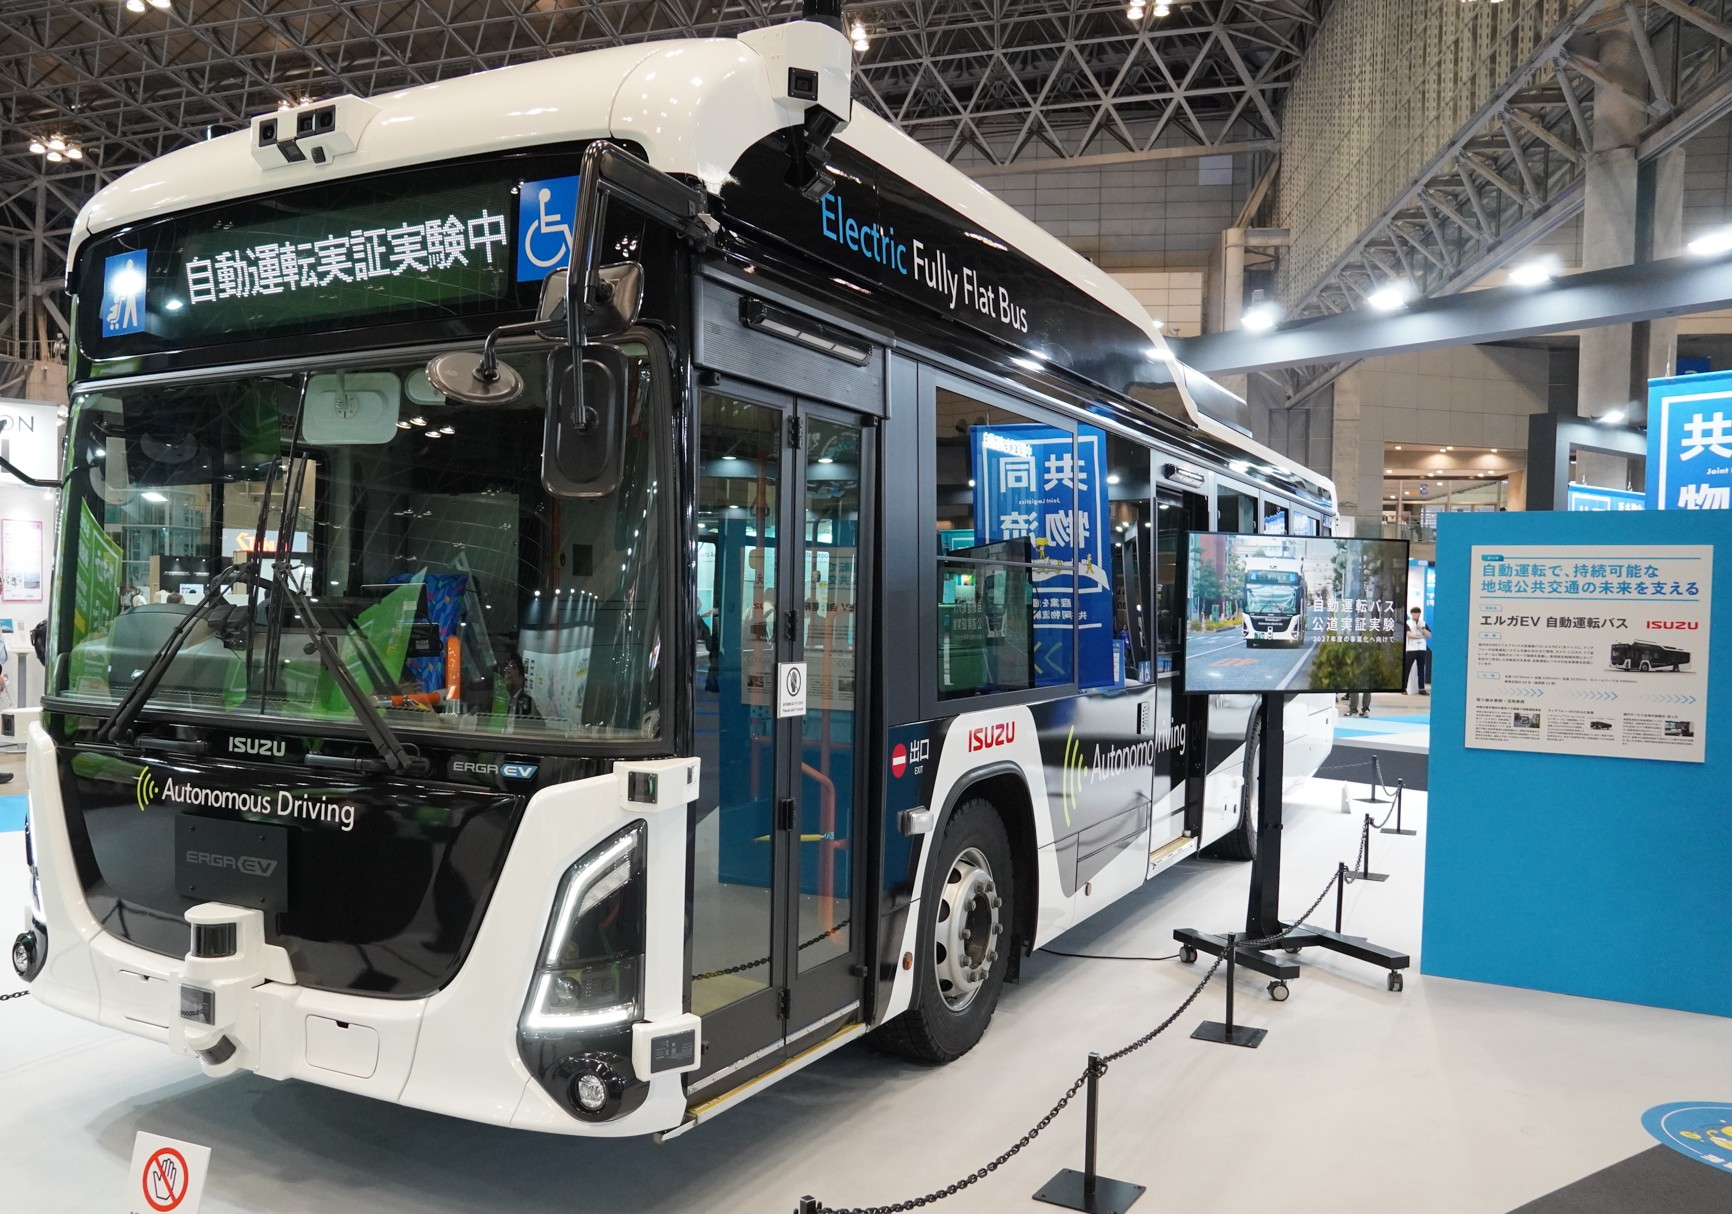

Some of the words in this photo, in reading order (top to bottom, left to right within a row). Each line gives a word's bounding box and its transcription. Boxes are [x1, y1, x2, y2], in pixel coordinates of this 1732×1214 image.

[186, 209, 507, 304] 自動運転実証実験中
[820, 193, 908, 275] Electric
[913, 239, 958, 309] Fully
[963, 266, 995, 318] Flat
[999, 286, 1028, 333] Bus
[1482, 563, 1659, 579] 自動運転で、持続可能な
[1481, 580, 1699, 596] 地域公共交通の未来を支える
[1313, 598, 1395, 613] 自動運転バス
[1312, 617, 1395, 632] 公道実証実験
[1480, 615, 1541, 627] エルガEV
[1546, 616, 1629, 629] 自動運転バス
[1646, 620, 1699, 630] ISUZU
[968, 721, 1015, 753] ISUZU
[1155, 716, 1187, 756] riving
[228, 736, 286, 757] ISUZU
[909, 738, 930, 764] 出口
[453, 761, 498, 775] ERGA
[502, 766, 534, 779] EV
[914, 765, 924, 775] EXIT
[161, 777, 271, 815] Autonomous
[277, 790, 356, 831] Driving
[186, 850, 237, 870] ERGA
[240, 857, 277, 877] EV
